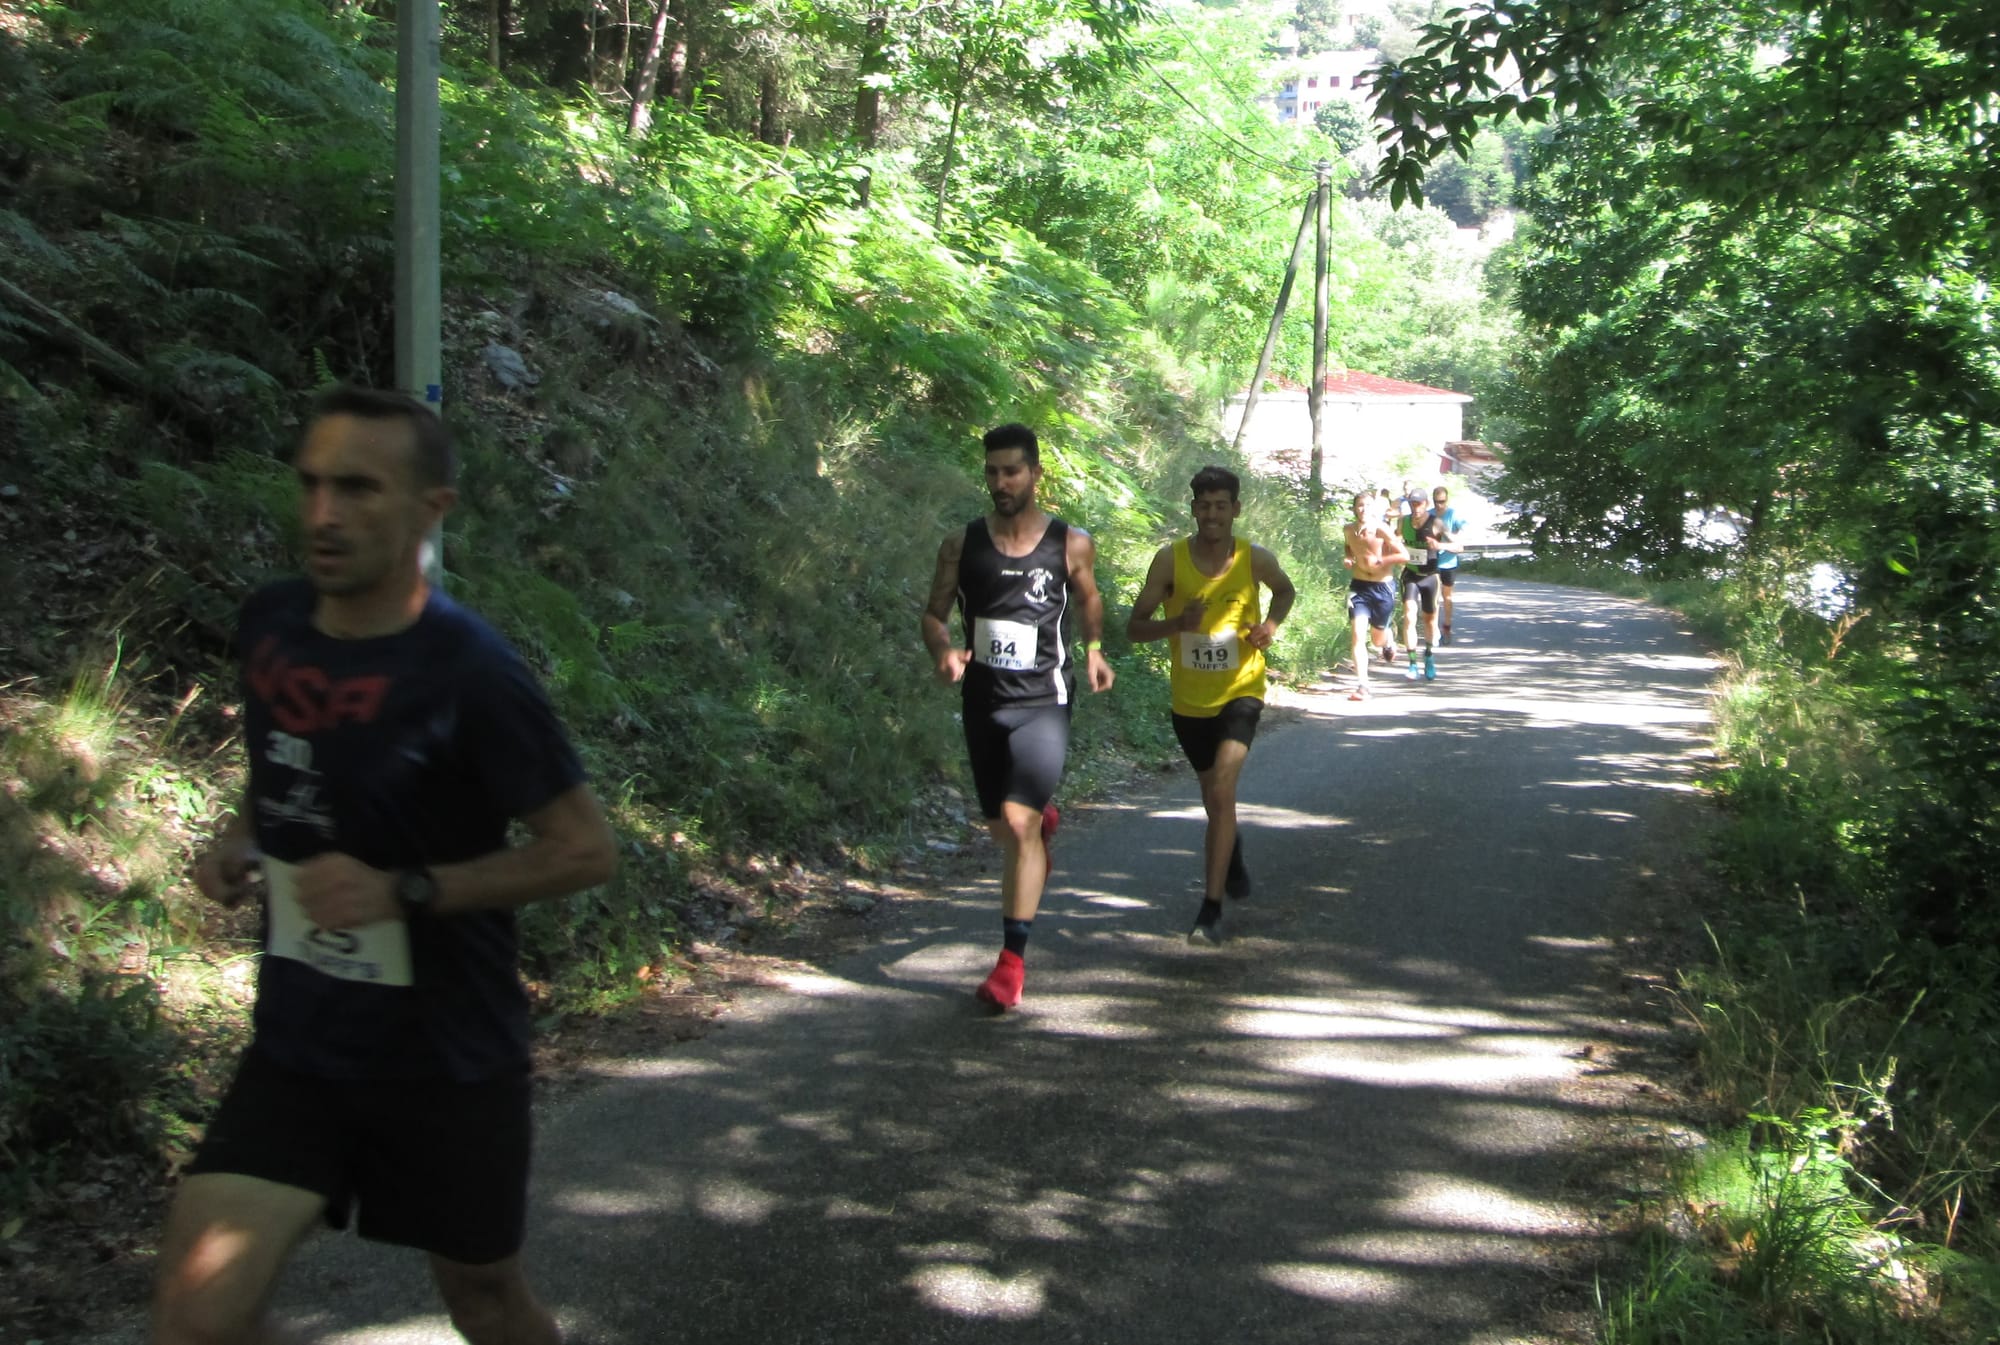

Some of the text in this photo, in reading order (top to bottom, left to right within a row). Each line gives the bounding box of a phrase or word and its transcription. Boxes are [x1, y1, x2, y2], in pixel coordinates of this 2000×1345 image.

[990, 639, 1017, 657] 84
[1191, 648, 1228, 662] 119
[1191, 661, 1228, 670] TUFF'S
